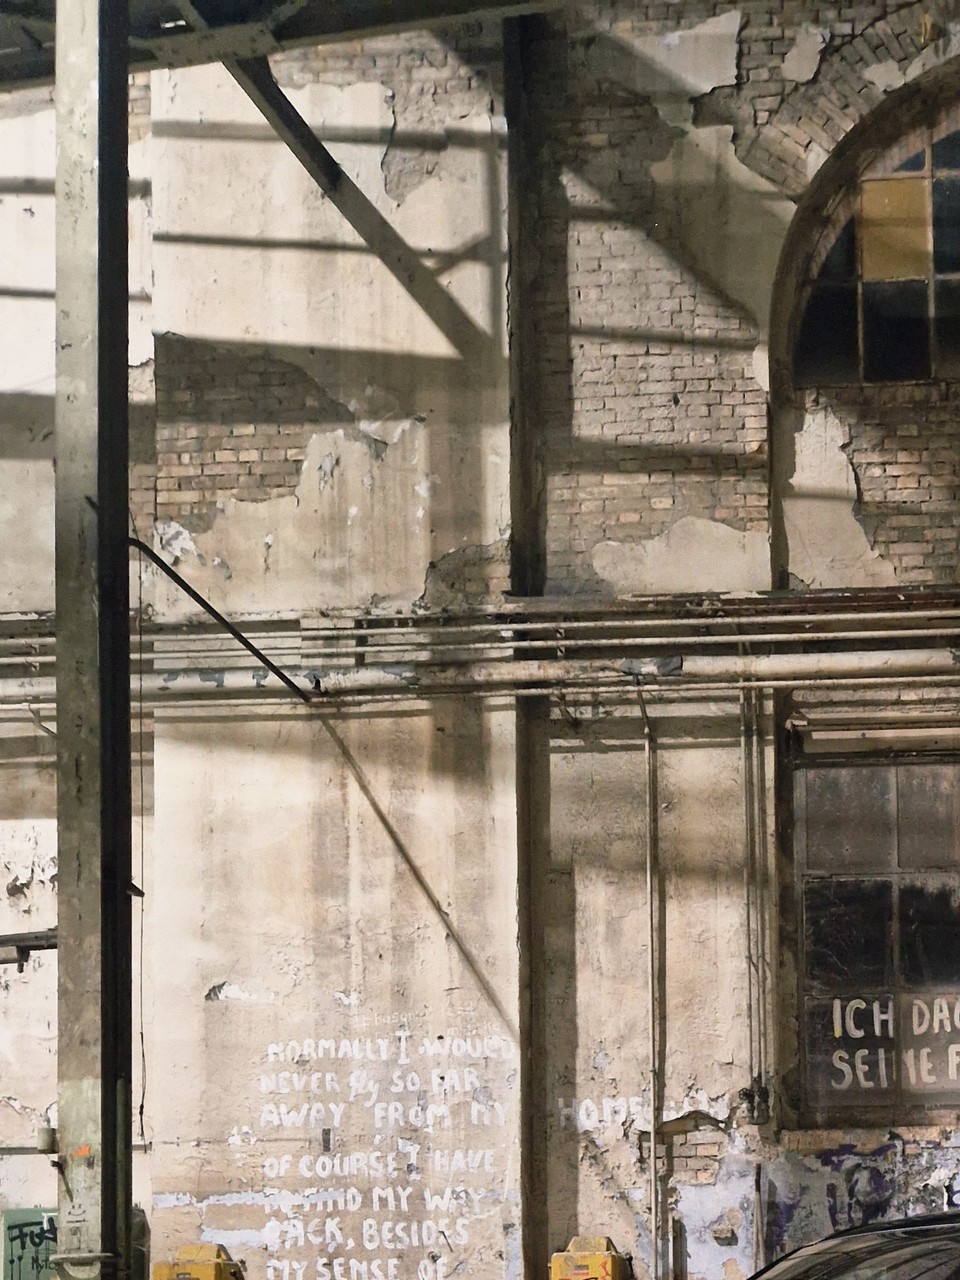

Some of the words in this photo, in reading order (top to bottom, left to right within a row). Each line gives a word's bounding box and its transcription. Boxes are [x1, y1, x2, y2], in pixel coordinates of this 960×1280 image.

[832, 998, 895, 1039] ICH
[267, 1038, 390, 1063] NORMALLY
[395, 1030, 411, 1065] I
[419, 1035, 516, 1062] WOULD
[260, 1071, 340, 1095] NEVER
[349, 1069, 380, 1107] fly
[390, 1070, 421, 1094] SO
[431, 1068, 481, 1095] FAR
[260, 1103, 345, 1130] AWAY
[374, 1101, 451, 1131] FROM
[471, 1101, 509, 1127] MY
[263, 1154, 292, 1178] OF
[298, 1150, 397, 1179] COURSE
[433, 1148, 497, 1174] HAVE
[371, 1186, 413, 1212] MY
[362, 1217, 469, 1250] BESIDES
